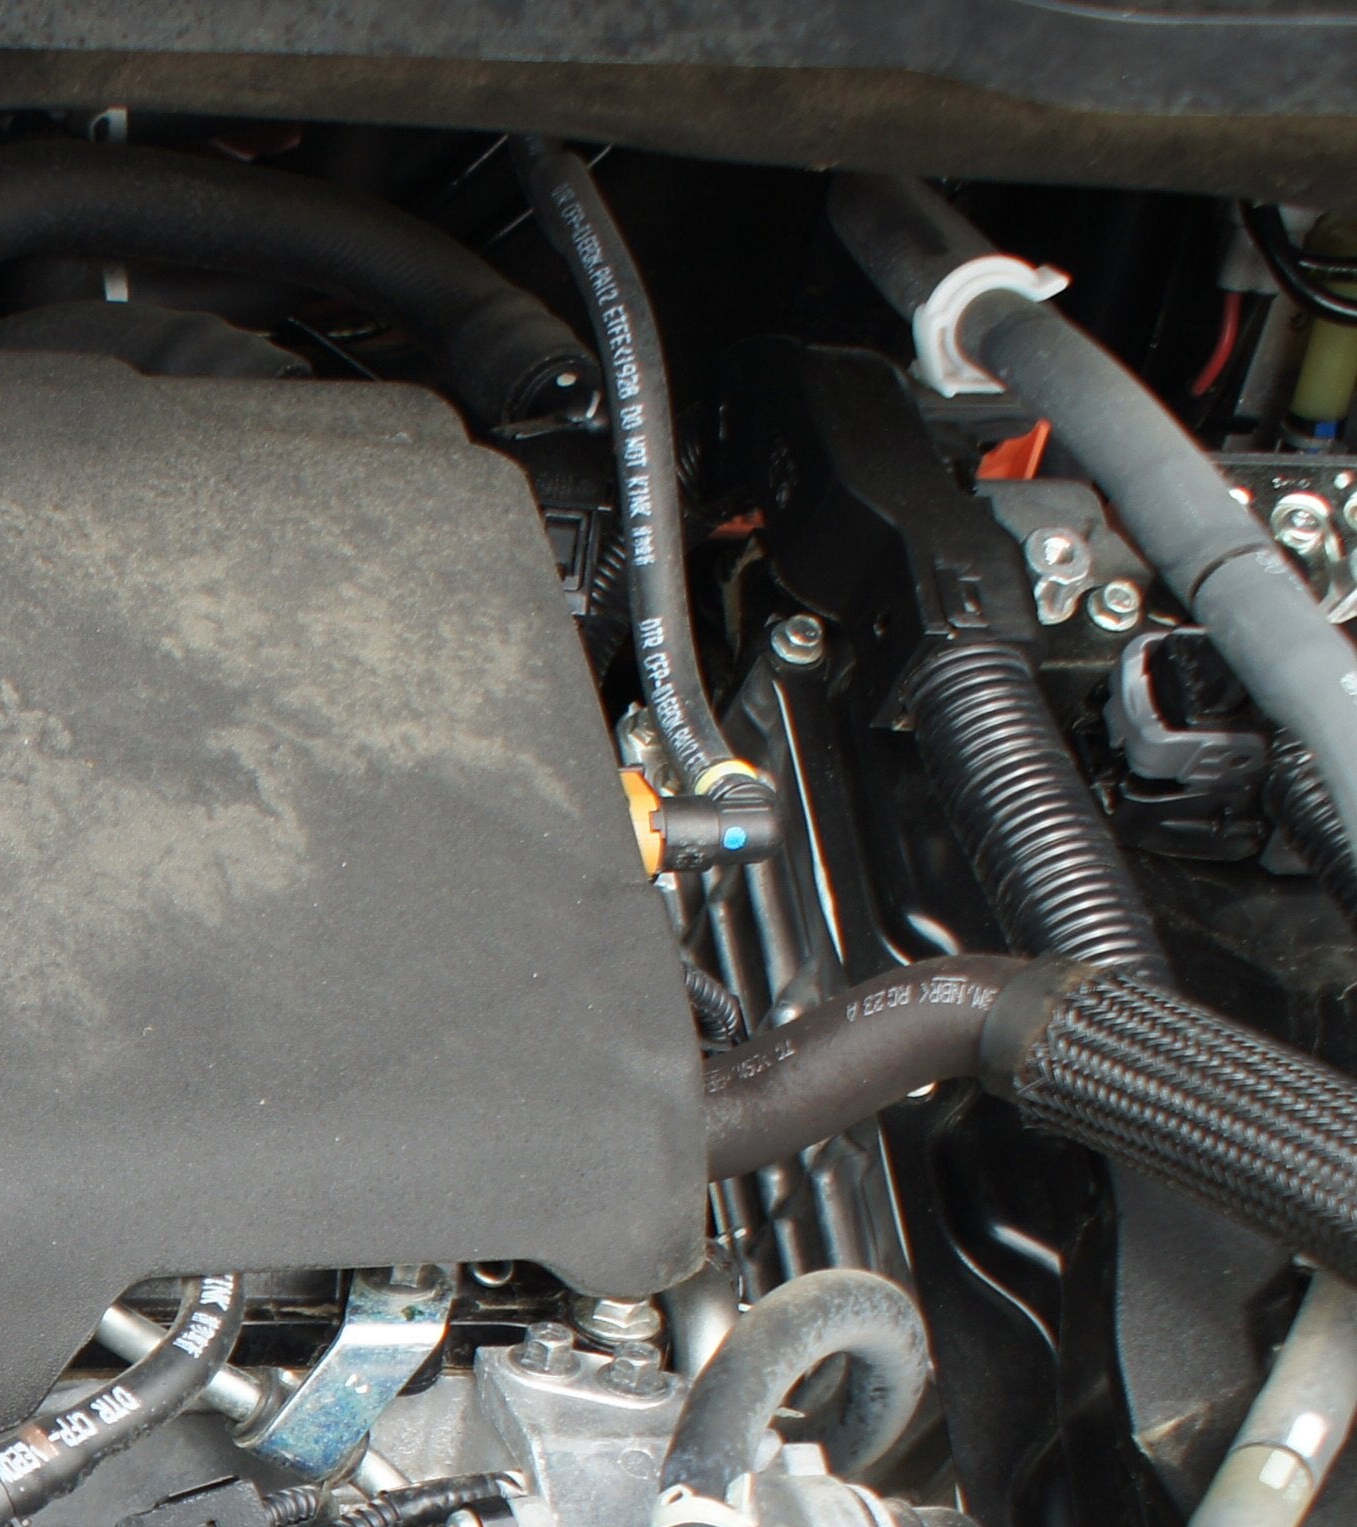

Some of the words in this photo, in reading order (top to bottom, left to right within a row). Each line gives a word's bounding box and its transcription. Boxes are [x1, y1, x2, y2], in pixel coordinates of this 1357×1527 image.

[620, 404, 644, 430] DO
[624, 434, 648, 467] NOT
[638, 617, 665, 650] DTR
[91, 1387, 142, 1425] DTR
